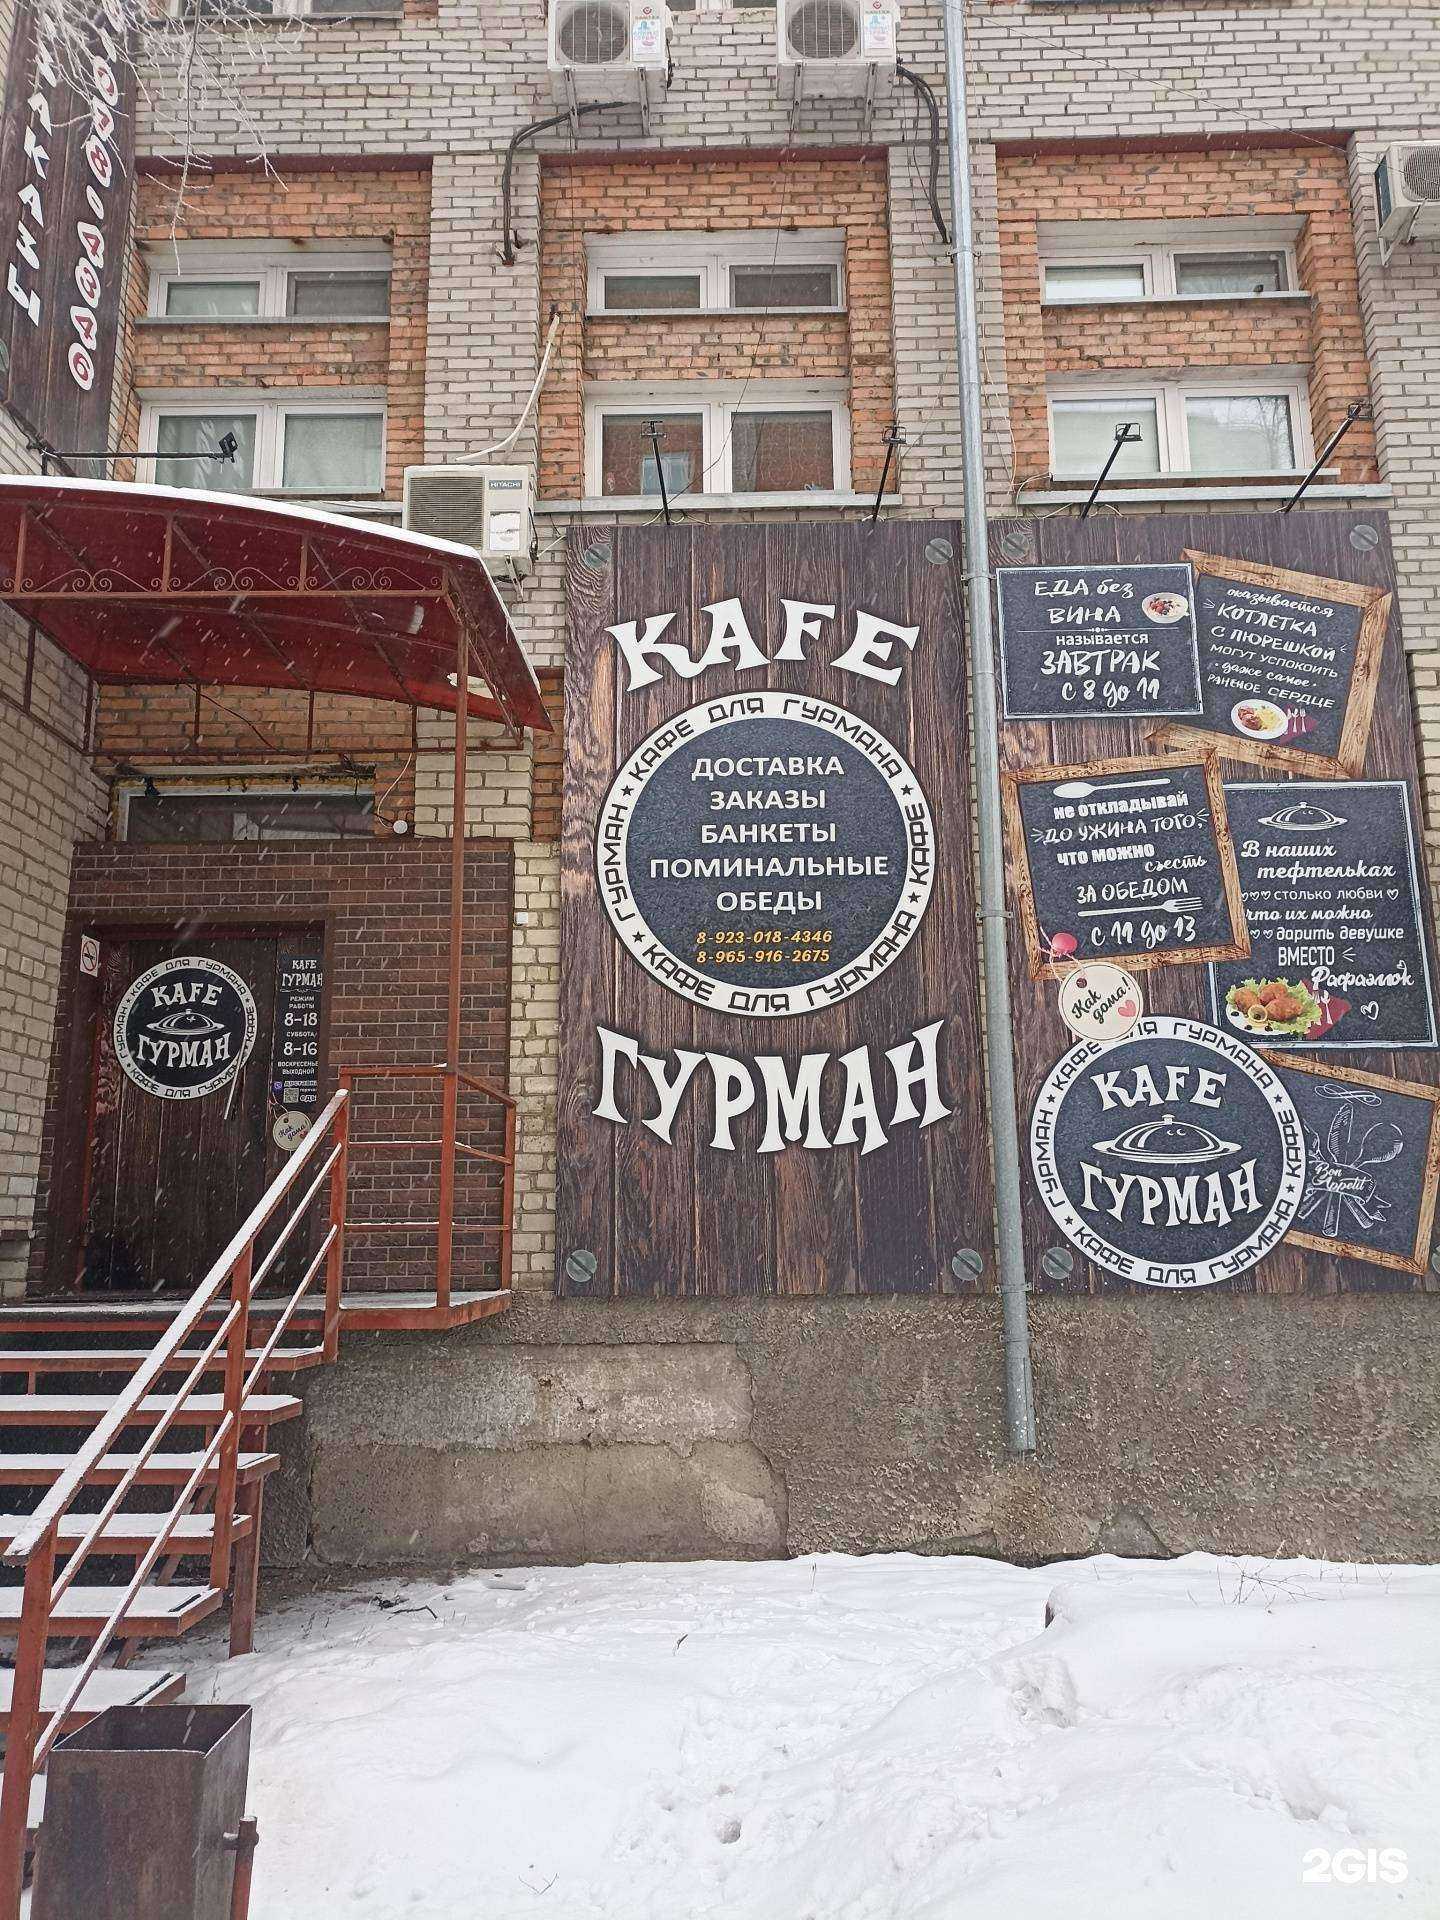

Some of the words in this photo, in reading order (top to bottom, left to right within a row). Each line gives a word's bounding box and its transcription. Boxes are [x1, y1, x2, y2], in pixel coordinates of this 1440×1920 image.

[1034, 578, 1089, 598] ЕДА
[1096, 578, 1134, 599] без
[1046, 605, 1121, 625] ВИНА
[1226, 588, 1335, 618] оказывается
[1217, 602, 1317, 637] КОТЛЕТКА
[604, 597, 920, 692] KAFE
[1055, 632, 1149, 646] называется
[1230, 629, 1336, 662] ПЮРЕШКОЙ
[1040, 649, 1161, 676] ЗАВТРАК
[1209, 644, 1256, 660] МОГУТ
[1260, 654, 1338, 678] УСПОКОИТЬ
[1221, 662, 1263, 678] даже
[1267, 671, 1310, 688] самое
[1083, 679, 1096, 700] 8
[1102, 679, 1131, 708] до
[1136, 676, 1161, 700] 11
[1207, 673, 1261, 694] РАНЕНОЕ
[1267, 687, 1335, 709] СЕРДЦЕ
[628, 718, 694, 783] КАФЕ
[707, 697, 764, 723] ДЛЯ
[783, 698, 903, 779] ГУРМАНА
[691, 756, 845, 782] ДОСТАВКА
[710, 789, 826, 811] ЗАКАЗЫ
[1053, 806, 1075, 820] не
[1078, 790, 1189, 817] откладывай
[701, 822, 836, 844] БАНКЕТЫ
[904, 802, 930, 886] КАФЕ
[1042, 828, 1073, 845] ДО
[1078, 818, 1147, 841] УЖИНА
[603, 803, 636, 922] ГУРМАН
[1056, 851, 1088, 866] что
[1092, 843, 1155, 864] можно
[1240, 840, 1260, 858] В
[1265, 844, 1337, 858] наших
[650, 856, 889, 879] ПОМИНАЛЬНЫЕ
[1144, 854, 1208, 873] съесть
[1257, 859, 1397, 885] тефтельках
[716, 890, 822, 916] ОБЕДЫ
[1076, 884, 1097, 905] ЗА
[1101, 876, 1189, 901] ОБЕДОМ
[1273, 888, 1332, 900] столько
[1336, 886, 1383, 900] любви
[1285, 909, 1309, 921] их
[1310, 904, 1374, 921] можно
[696, 930, 833, 945] 8-923-018-4346
[1110, 920, 1134, 945] 11
[1140, 920, 1168, 949] до
[1173, 914, 1196, 942] 13
[1276, 926, 1335, 943] дарить
[1339, 925, 1405, 943] девушке
[292, 960, 317, 970] KAFE
[642, 942, 716, 1002] КАФЕ
[727, 991, 790, 1012] ДЛЯ
[806, 910, 917, 1006] ГУРМАНА
[696, 949, 830, 964] 8-965-916-2675
[1278, 946, 1335, 967] ВМЕСТО
[131, 969, 159, 997] КАФЕ
[165, 959, 190, 971] ДЛЯ
[198, 959, 247, 996] ГУРМАНА
[282, 973, 323, 987] ГУРМАН
[150, 982, 223, 1007] KAFE
[1071, 989, 1102, 1019] Как
[1092, 976, 1131, 1025] дома!
[116, 1006, 129, 1059] ГУРМАН
[285, 1013, 318, 1026] 8-18
[136, 1032, 232, 1068] ГУРМАН
[284, 1042, 318, 1055] 8-16
[1052, 1041, 1102, 1091] КАФЕ
[1173, 1022, 1274, 1090] ГУРМАНА
[130, 1067, 160, 1093] КАФЕ
[164, 1088, 191, 1098] ДЛЯ
[591, 1020, 953, 1155] ГУРМАН
[1090, 1064, 1228, 1112] KAFE
[1278, 1109, 1302, 1178] КАФЕ
[1036, 1109, 1065, 1208] ГУРМАН
[1315, 1162, 1343, 1179] Bon
[1079, 1158, 1264, 1227] ГУРМАН
[1312, 1176, 1366, 1191] Appetit
[1073, 1226, 1135, 1275] КАФЕ
[1146, 1266, 1197, 1285] ДЛЯ
[1208, 1198, 1295, 1280] ГУРМАНА
